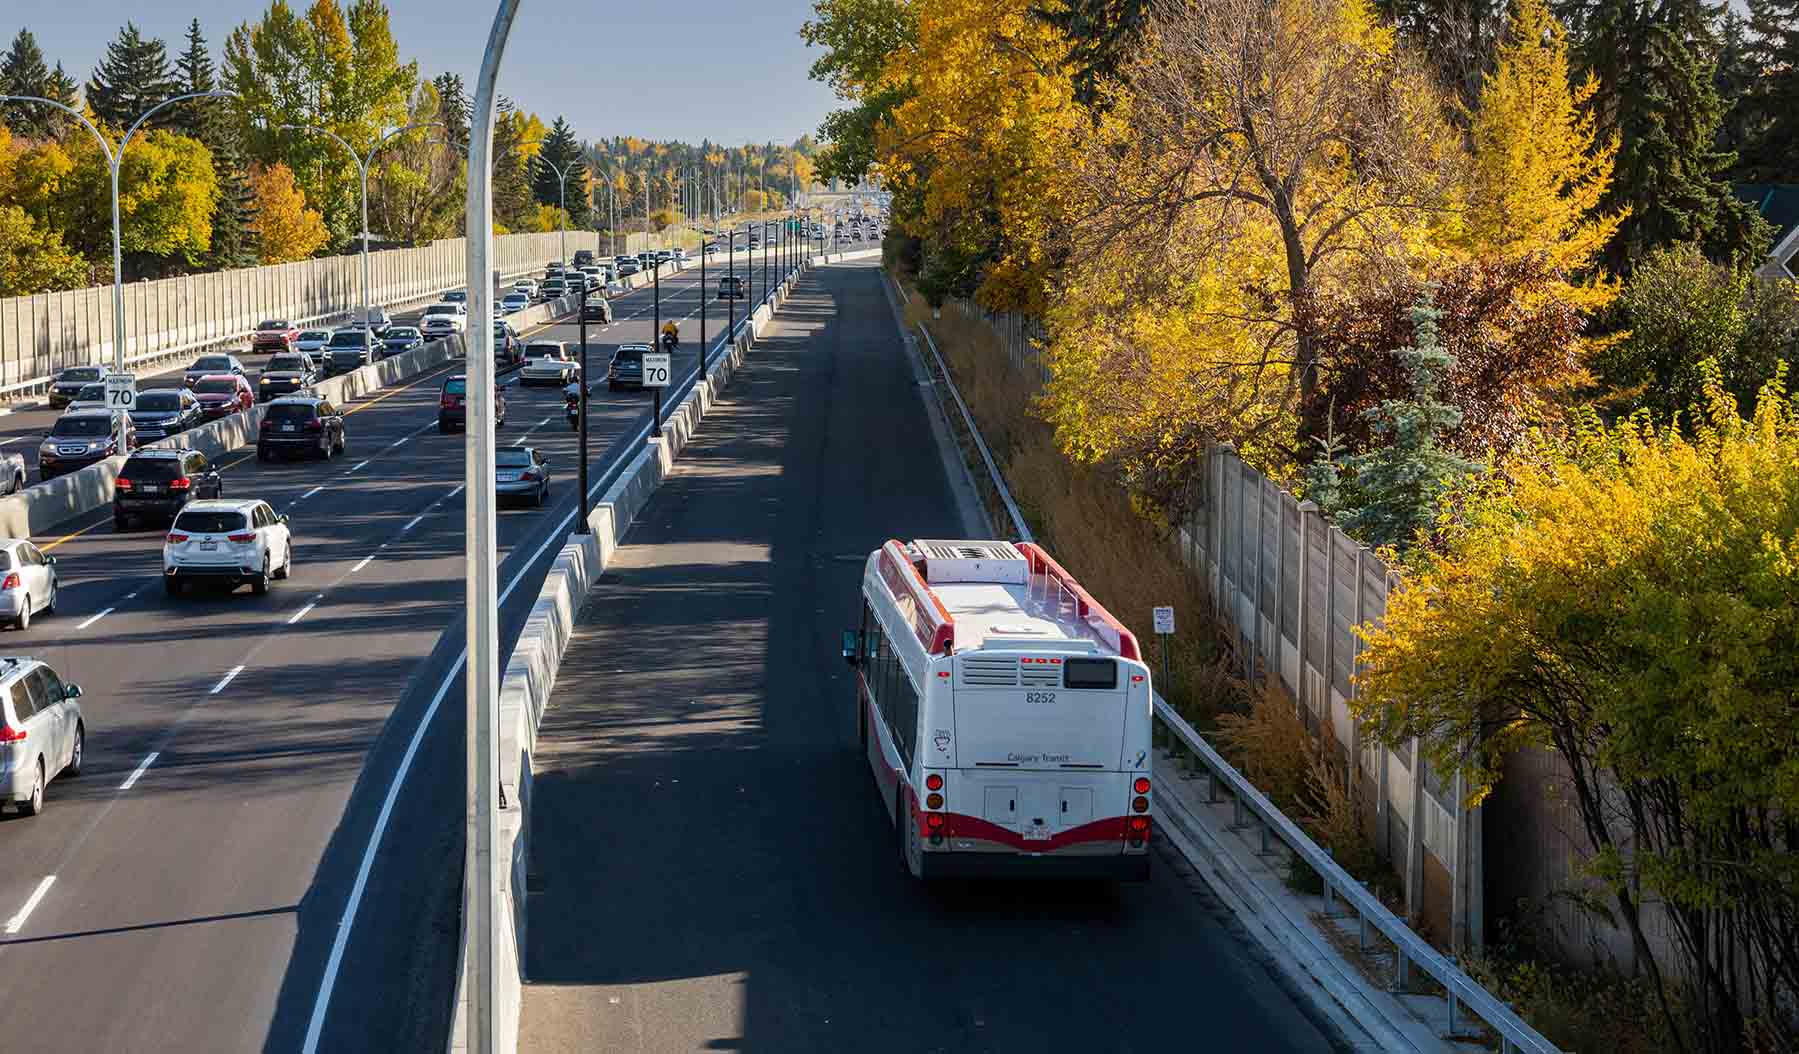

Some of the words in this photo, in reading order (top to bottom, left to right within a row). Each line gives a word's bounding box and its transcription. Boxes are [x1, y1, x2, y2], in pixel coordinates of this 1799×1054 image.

[646, 367, 667, 382] 70
[109, 390, 132, 405] 70
[1026, 692, 1056, 704] 8252
[1008, 752, 1039, 764] Calgary
